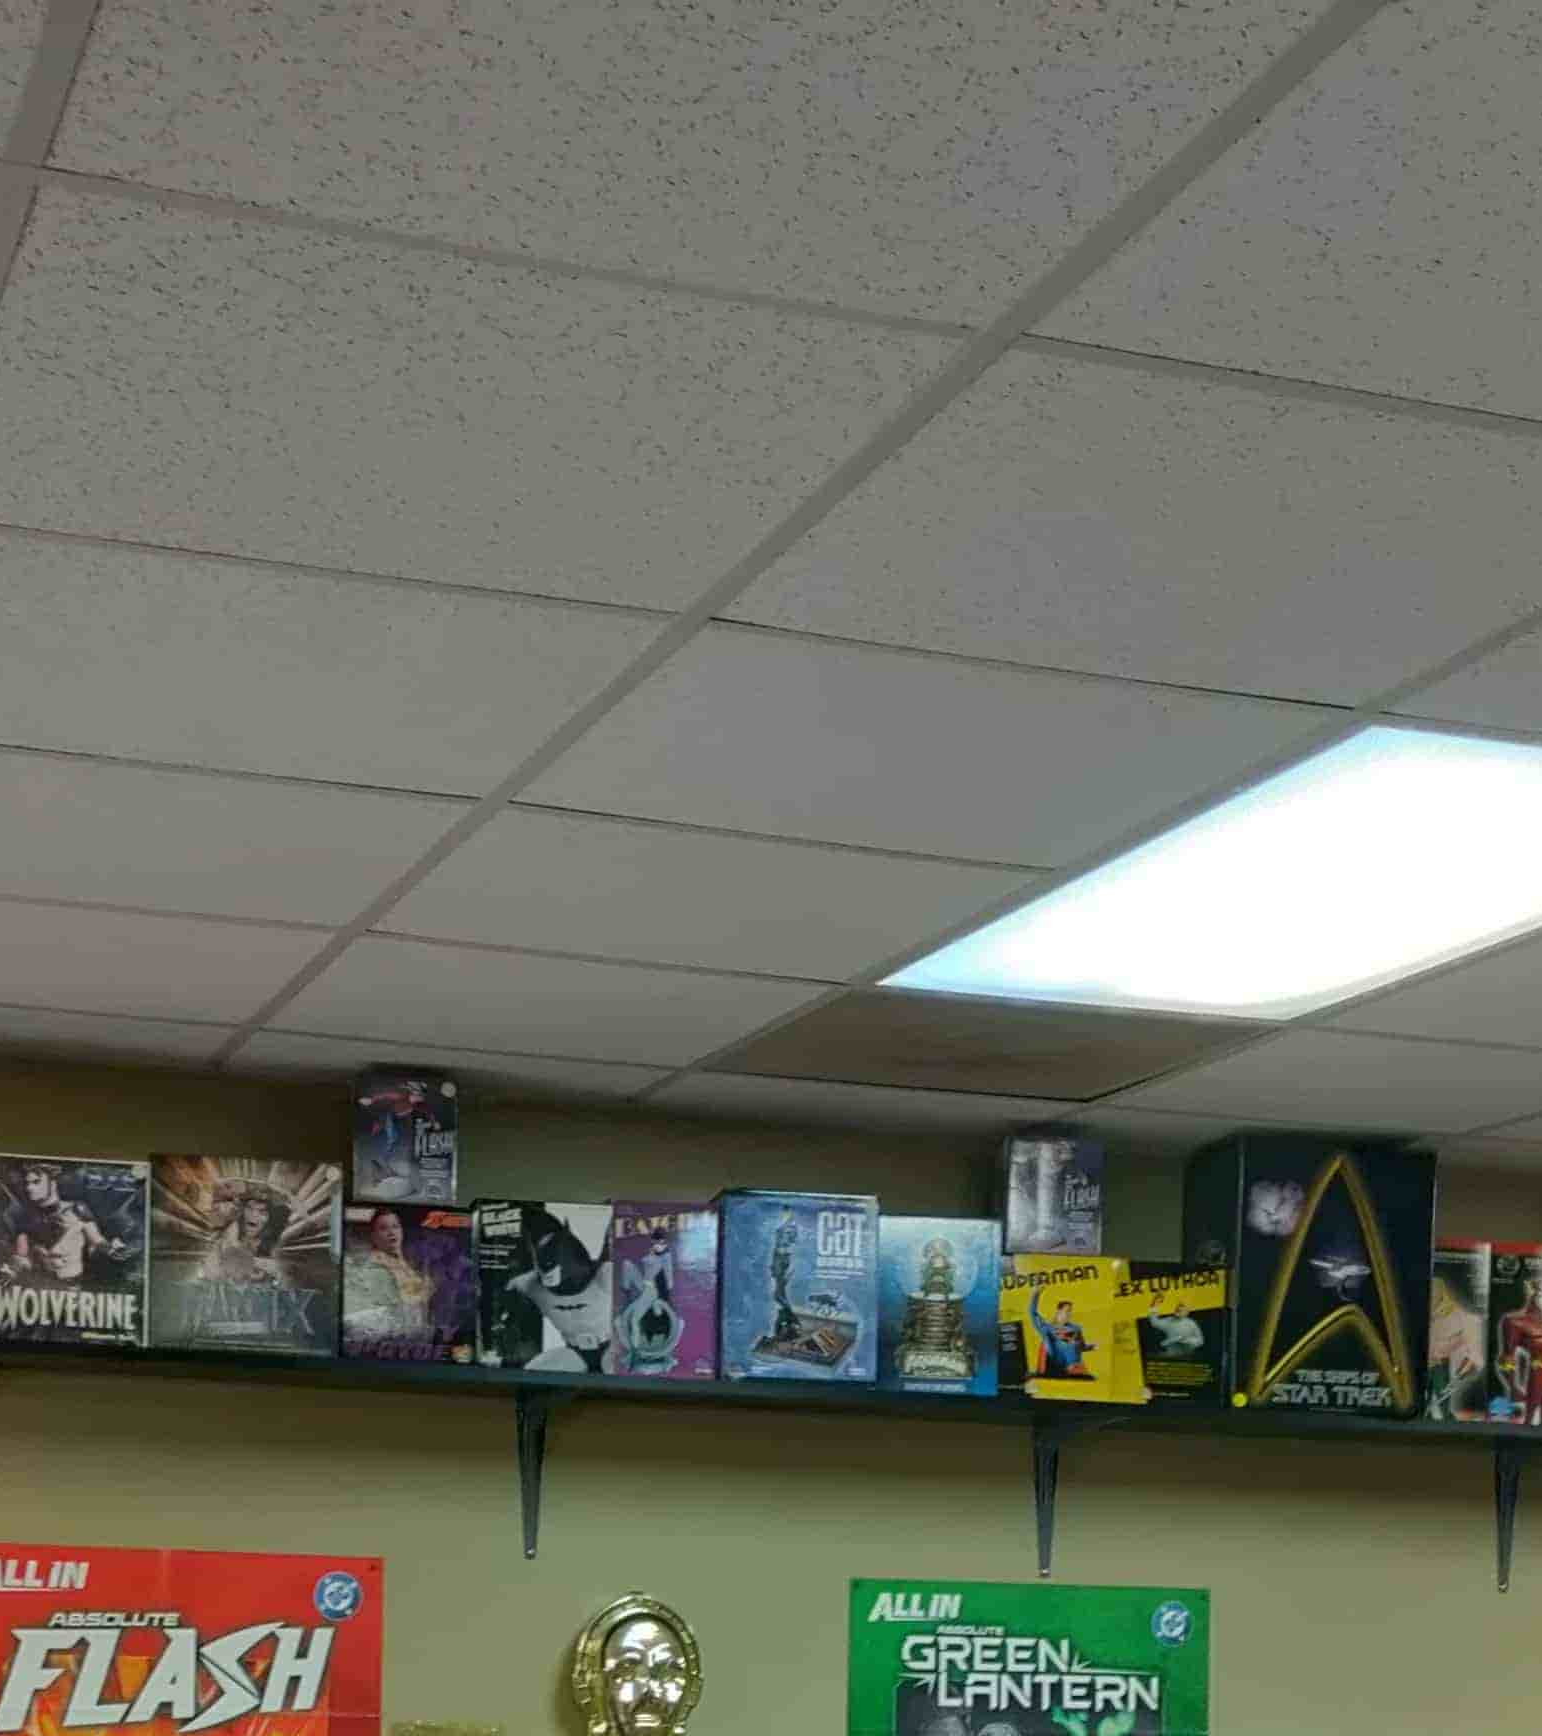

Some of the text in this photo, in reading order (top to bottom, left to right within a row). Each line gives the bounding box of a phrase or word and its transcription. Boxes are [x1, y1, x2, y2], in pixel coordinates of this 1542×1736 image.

[1002, 1264, 1100, 1291] UPERMAN
[1148, 1270, 1220, 1295] LUTHOR
[1272, 1383, 1392, 1406] STAR TREK
[46, 1560, 90, 1591] IN
[47, 1611, 181, 1628] ABSOLUTE
[867, 1592, 962, 1622] ALL IN
[936, 1624, 1005, 1637] ABSOLUTE
[899, 1634, 1073, 1673] GREEN
[935, 1670, 1160, 1712] LANTERN
